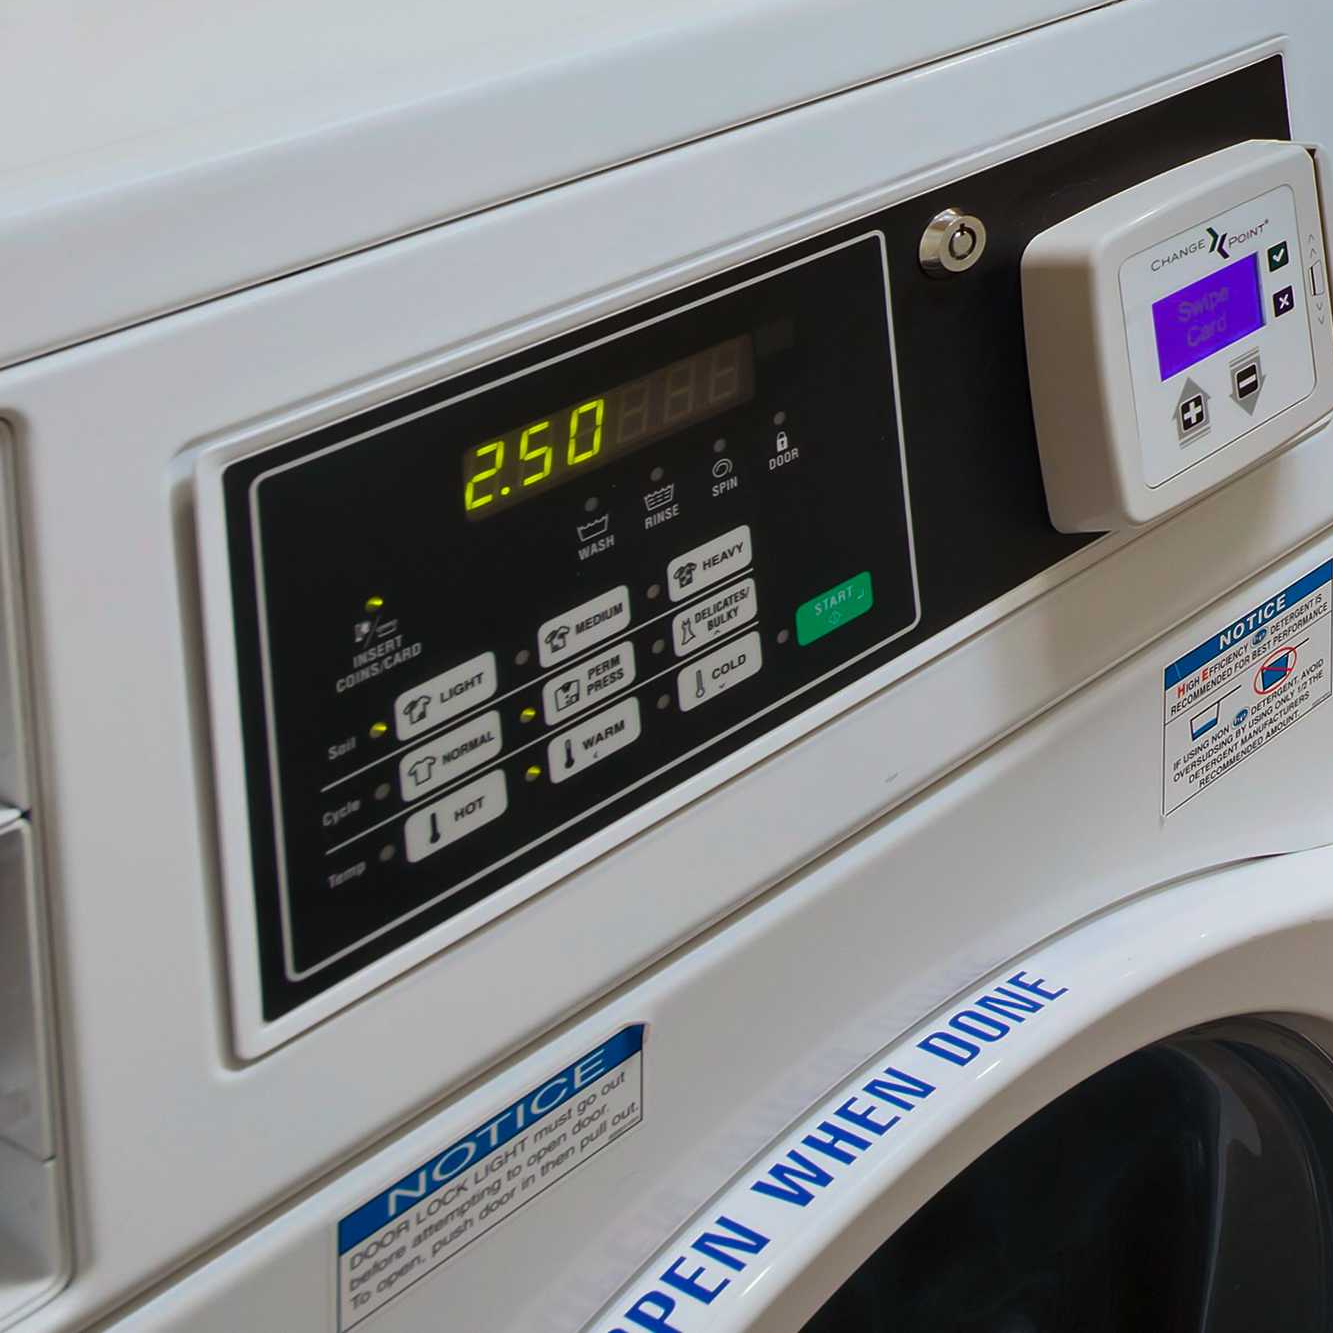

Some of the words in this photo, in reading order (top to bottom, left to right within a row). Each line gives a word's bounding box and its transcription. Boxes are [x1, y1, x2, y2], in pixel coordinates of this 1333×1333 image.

[1150, 239, 1206, 272] CHANGE
[1178, 286, 1229, 322] Swipe
[1187, 311, 1227, 347] Card
[465, 398, 605, 511] 2.50
[767, 447, 800, 470] DOOR
[711, 476, 739, 498] SPIN
[644, 504, 680, 530] RINSE
[577, 535, 615, 561] WASH
[702, 541, 745, 572] HEAVY
[694, 586, 751, 624] DELICATES/
[814, 585, 853, 617] START
[575, 602, 624, 636] MEDIUM
[707, 606, 740, 632] BULKY
[1219, 593, 1287, 650] NOTICE
[352, 634, 403, 669] INSERT
[1170, 667, 1233, 716] RECOMMENDED
[1234, 656, 1250, 673] FOR
[1252, 642, 1271, 660] BEST
[1273, 602, 1328, 646] PERFORMANCE
[1177, 677, 1200, 699] HIGH
[1201, 644, 1249, 682] EFFICIENCY
[1270, 598, 1314, 635] DETERGENT
[1315, 593, 1323, 604] IS
[335, 642, 422, 693] COINS/CARD
[586, 668, 625, 696] PRESS
[587, 655, 621, 681] PERM
[711, 654, 747, 681] COLD
[439, 672, 484, 704] LIGHT
[1173, 760, 1182, 771] IF
[1183, 740, 1210, 764] USING
[1211, 725, 1230, 744] NON
[1301, 658, 1324, 679] AVOID
[1173, 736, 1233, 782] OVERSUDSING
[1235, 723, 1248, 739] BY
[1248, 706, 1274, 729] USING
[1274, 688, 1296, 712] ONLY
[1308, 669, 1324, 688] THE
[328, 737, 357, 761] Soil
[441, 731, 495, 765] NORMAL
[582, 720, 626, 751] WARM
[1188, 743, 1239, 784] DETERGENT
[1240, 691, 1310, 747] MANUFACTURERS
[1199, 737, 1264, 788] RECOMMENDED
[322, 798, 362, 827] Cycle
[454, 796, 485, 822] HOT
[328, 861, 367, 889] Temp
[388, 1048, 606, 1217] NOTICE
[607, 1215, 771, 1333] PEN
[750, 1067, 937, 1208] WHEN
[915, 970, 1069, 1067] DONE
[350, 1219, 411, 1272] DOOR
[415, 1182, 469, 1226] LOCK
[474, 1136, 529, 1185] LIGHT
[533, 1107, 573, 1144] must
[577, 1093, 597, 1115] go
[601, 1071, 626, 1096] out
[348, 1243, 407, 1292] before
[411, 1178, 502, 1249] attempting
[506, 1165, 522, 1182] to
[526, 1132, 567, 1167] open
[571, 1103, 610, 1136] door.
[349, 1289, 371, 1310] To
[431, 1218, 474, 1259] push
[478, 1186, 517, 1221] door
[521, 1174, 535, 1191] in
[540, 1147, 575, 1177] then
[580, 1122, 607, 1153] pull
[611, 1102, 639, 1127] out.
